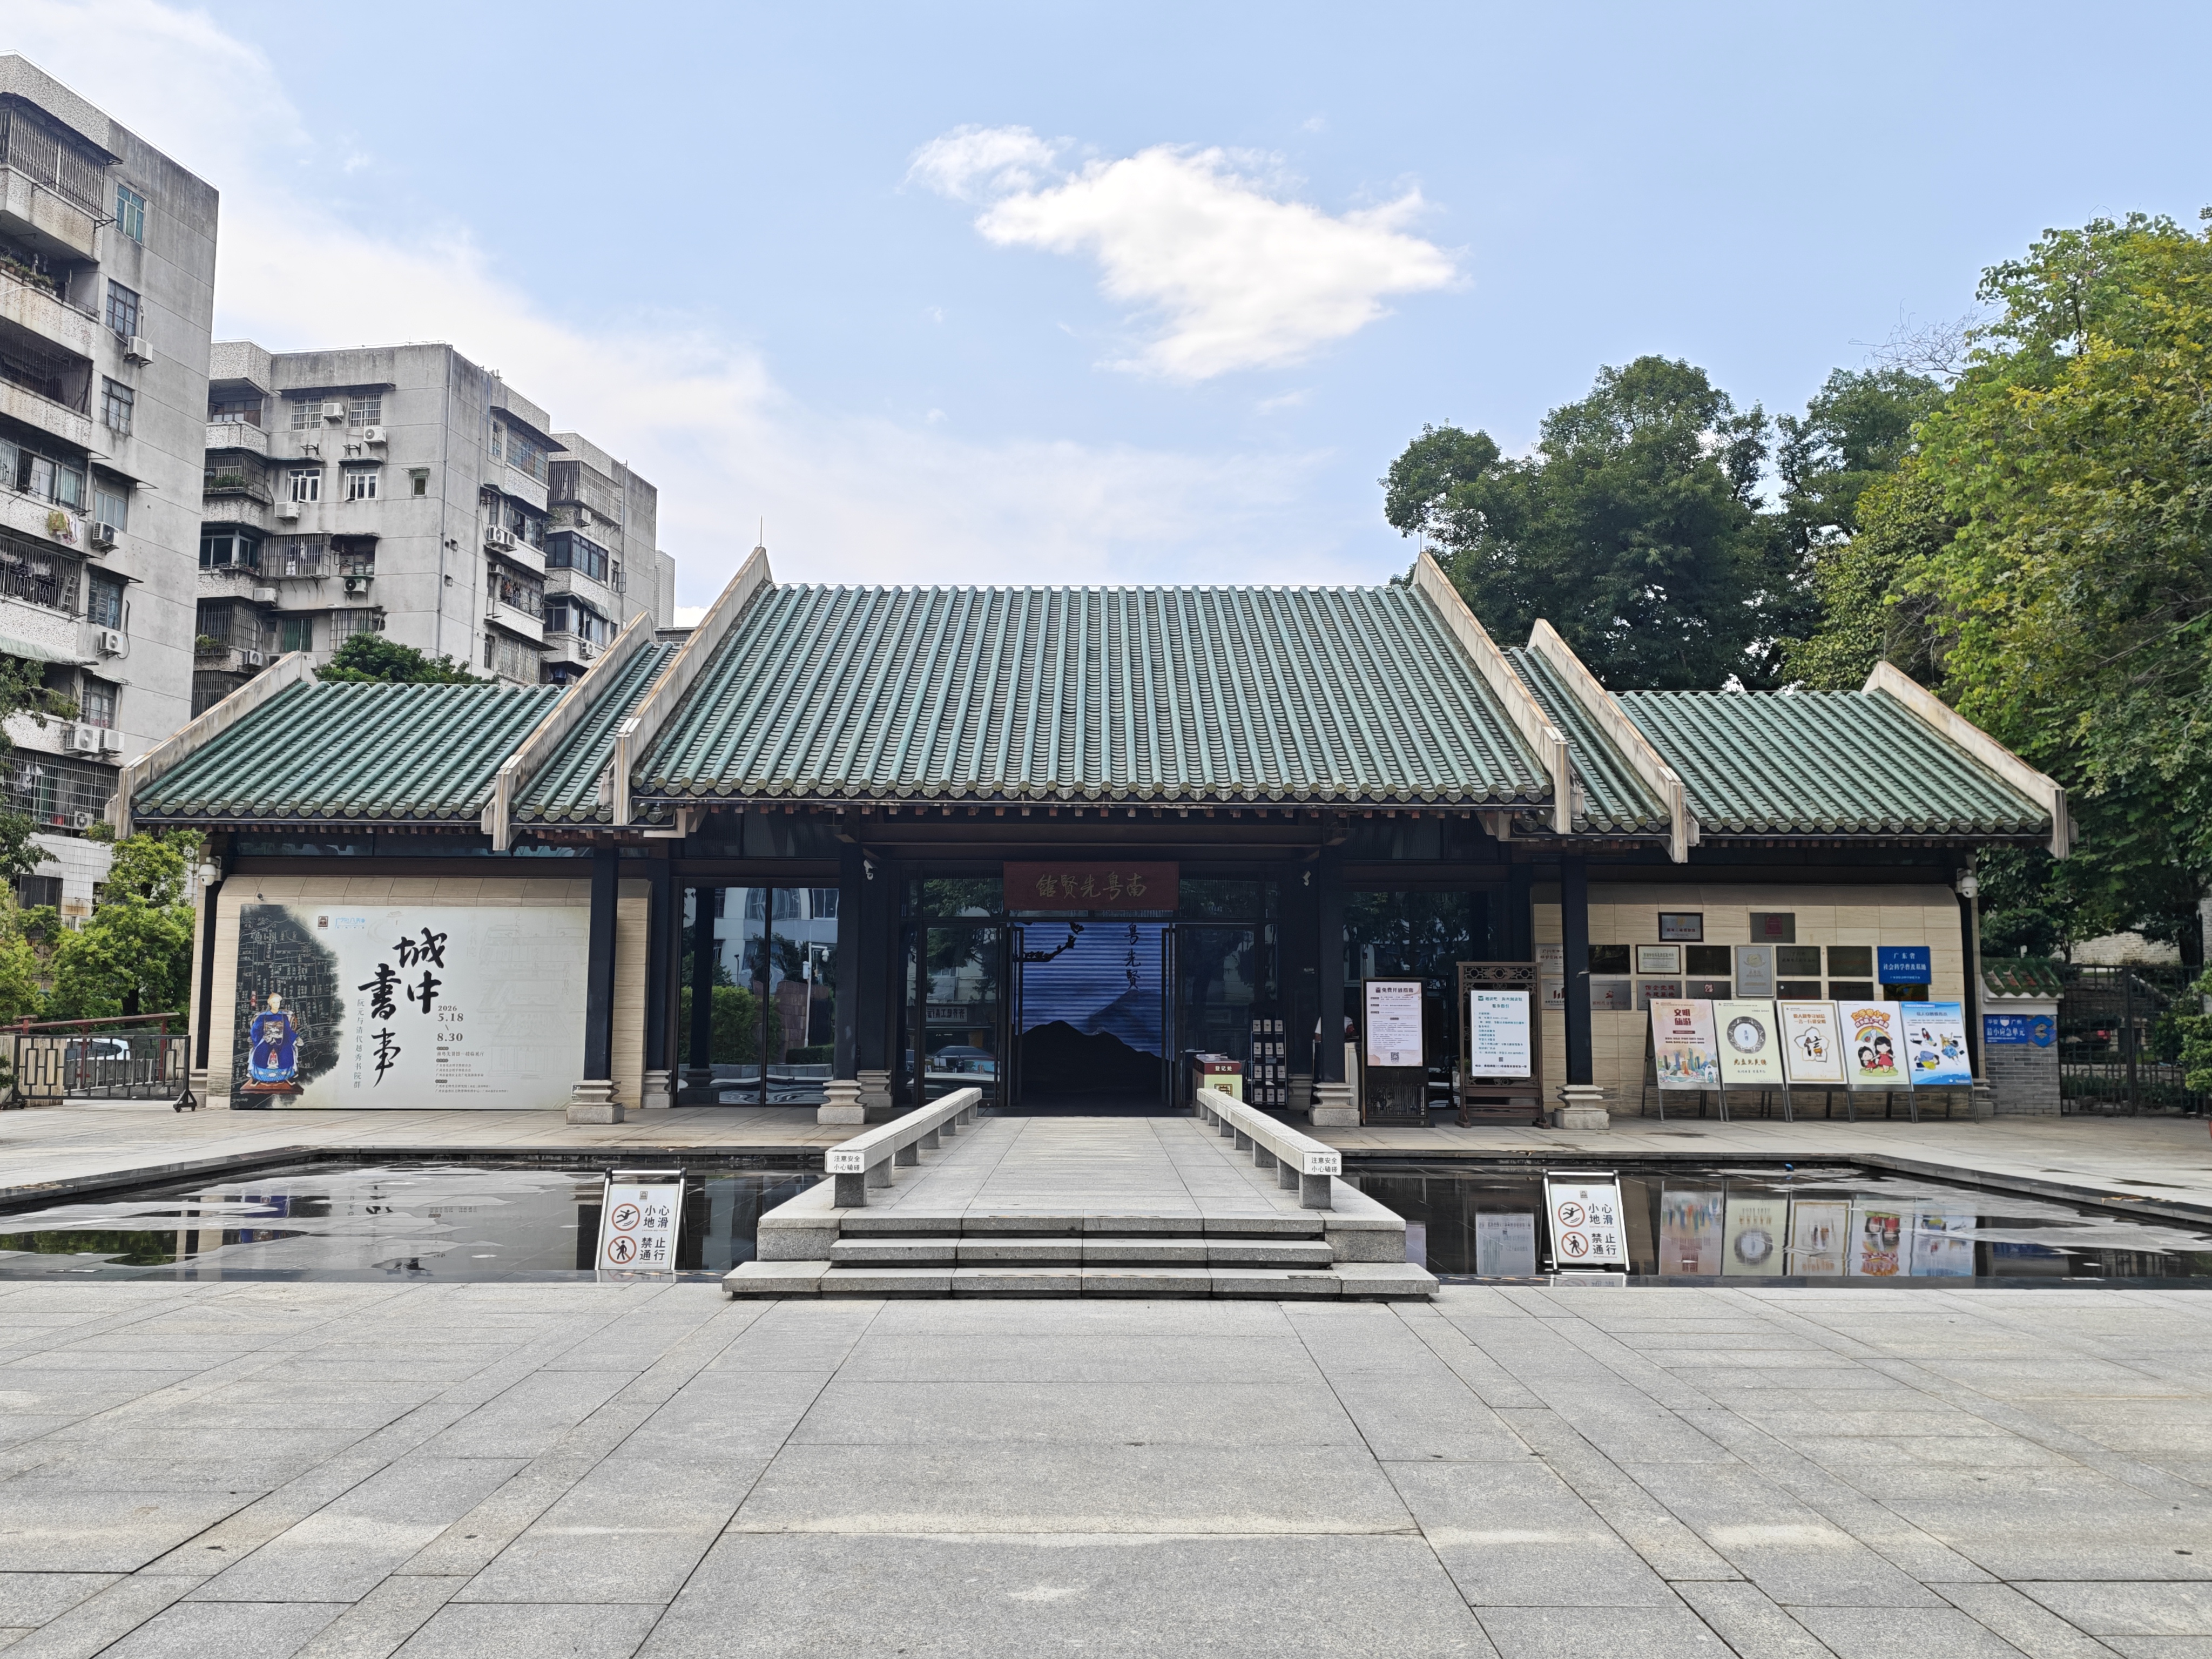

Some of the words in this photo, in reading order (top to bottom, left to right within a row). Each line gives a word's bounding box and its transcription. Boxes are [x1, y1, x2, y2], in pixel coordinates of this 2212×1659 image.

[437, 1013, 464, 1022] 5.18
[1674, 1008, 1690, 1016] 文明
[1675, 1017, 1691, 1026] 旅游
[1987, 1027, 2025, 1036] 最小应急单元
[437, 1033, 463, 1042] 8.30
[354, 999, 365, 1089] 阮元与清代越秀书院群
[644, 1205, 670, 1216] 小心
[1588, 1203, 1612, 1213] 小心
[643, 1217, 668, 1228] 地滑
[1589, 1214, 1613, 1225] 地滑
[641, 1237, 666, 1249] 禁止
[1591, 1233, 1616, 1244] 禁止
[639, 1249, 665, 1261] 通行
[1593, 1244, 1617, 1255] 通行
